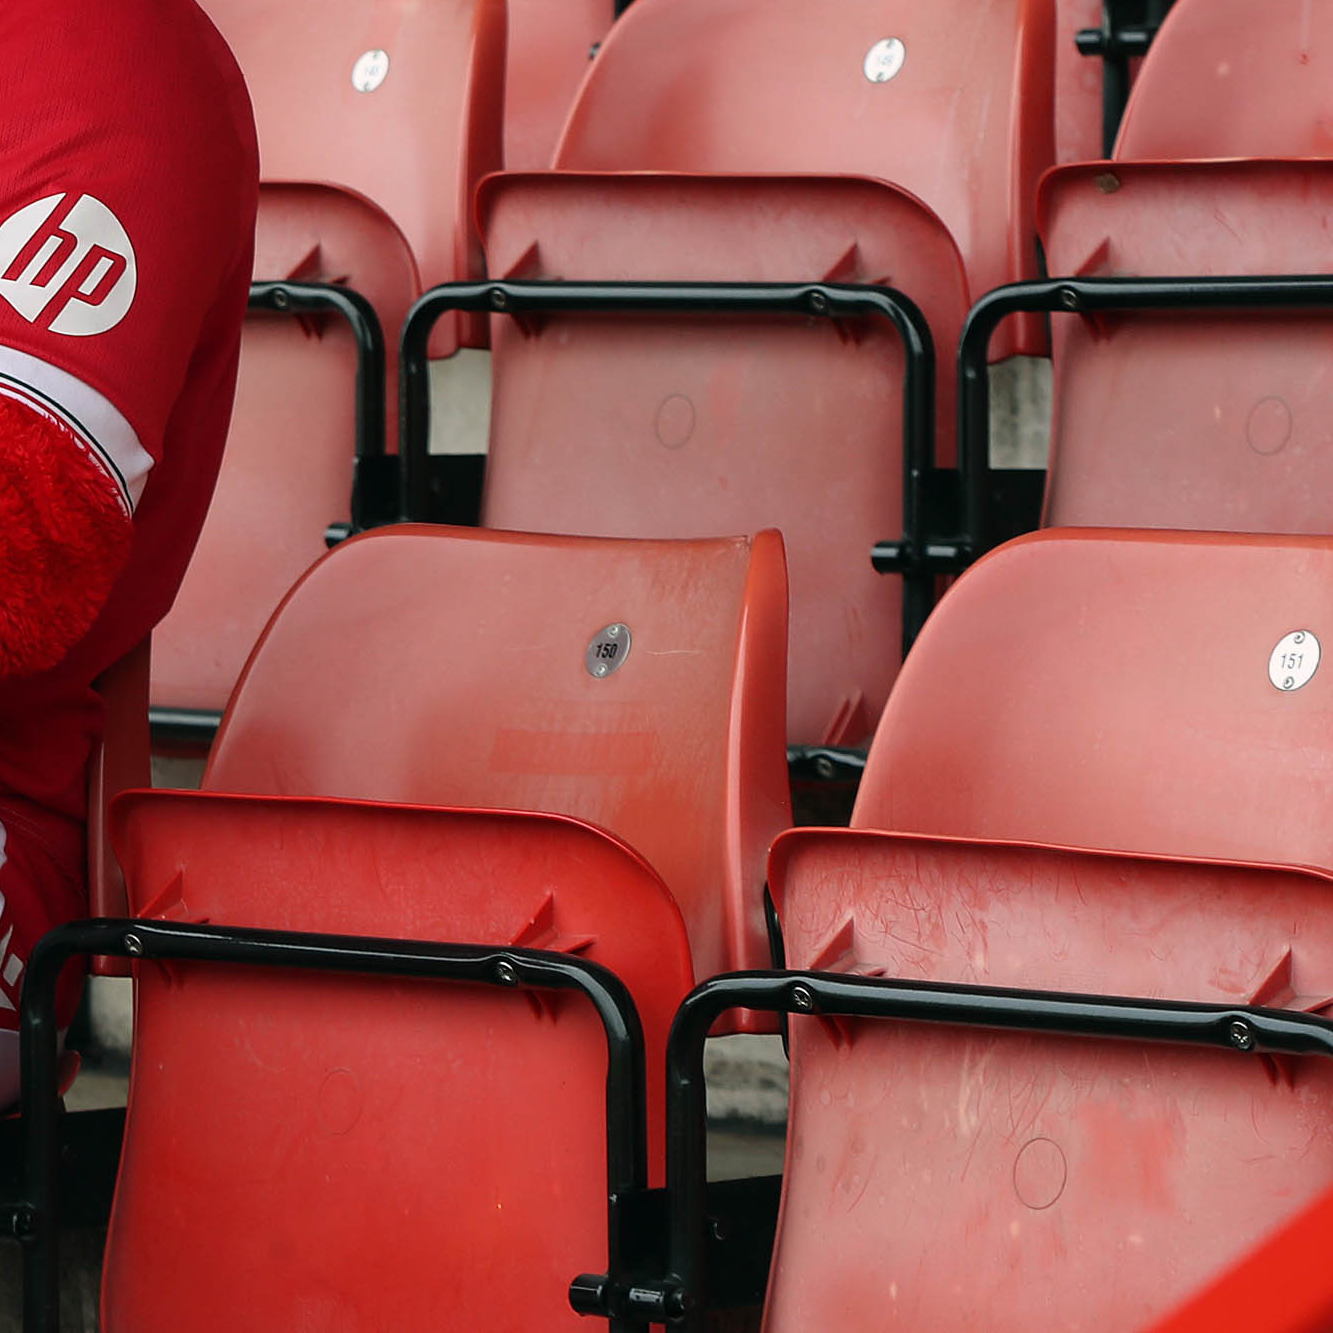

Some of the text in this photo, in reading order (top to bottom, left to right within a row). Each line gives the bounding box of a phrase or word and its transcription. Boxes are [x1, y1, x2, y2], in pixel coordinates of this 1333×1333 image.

[0, 192, 128, 327] hp
[596, 643, 618, 658] 150
[1281, 653, 1304, 670] 151
